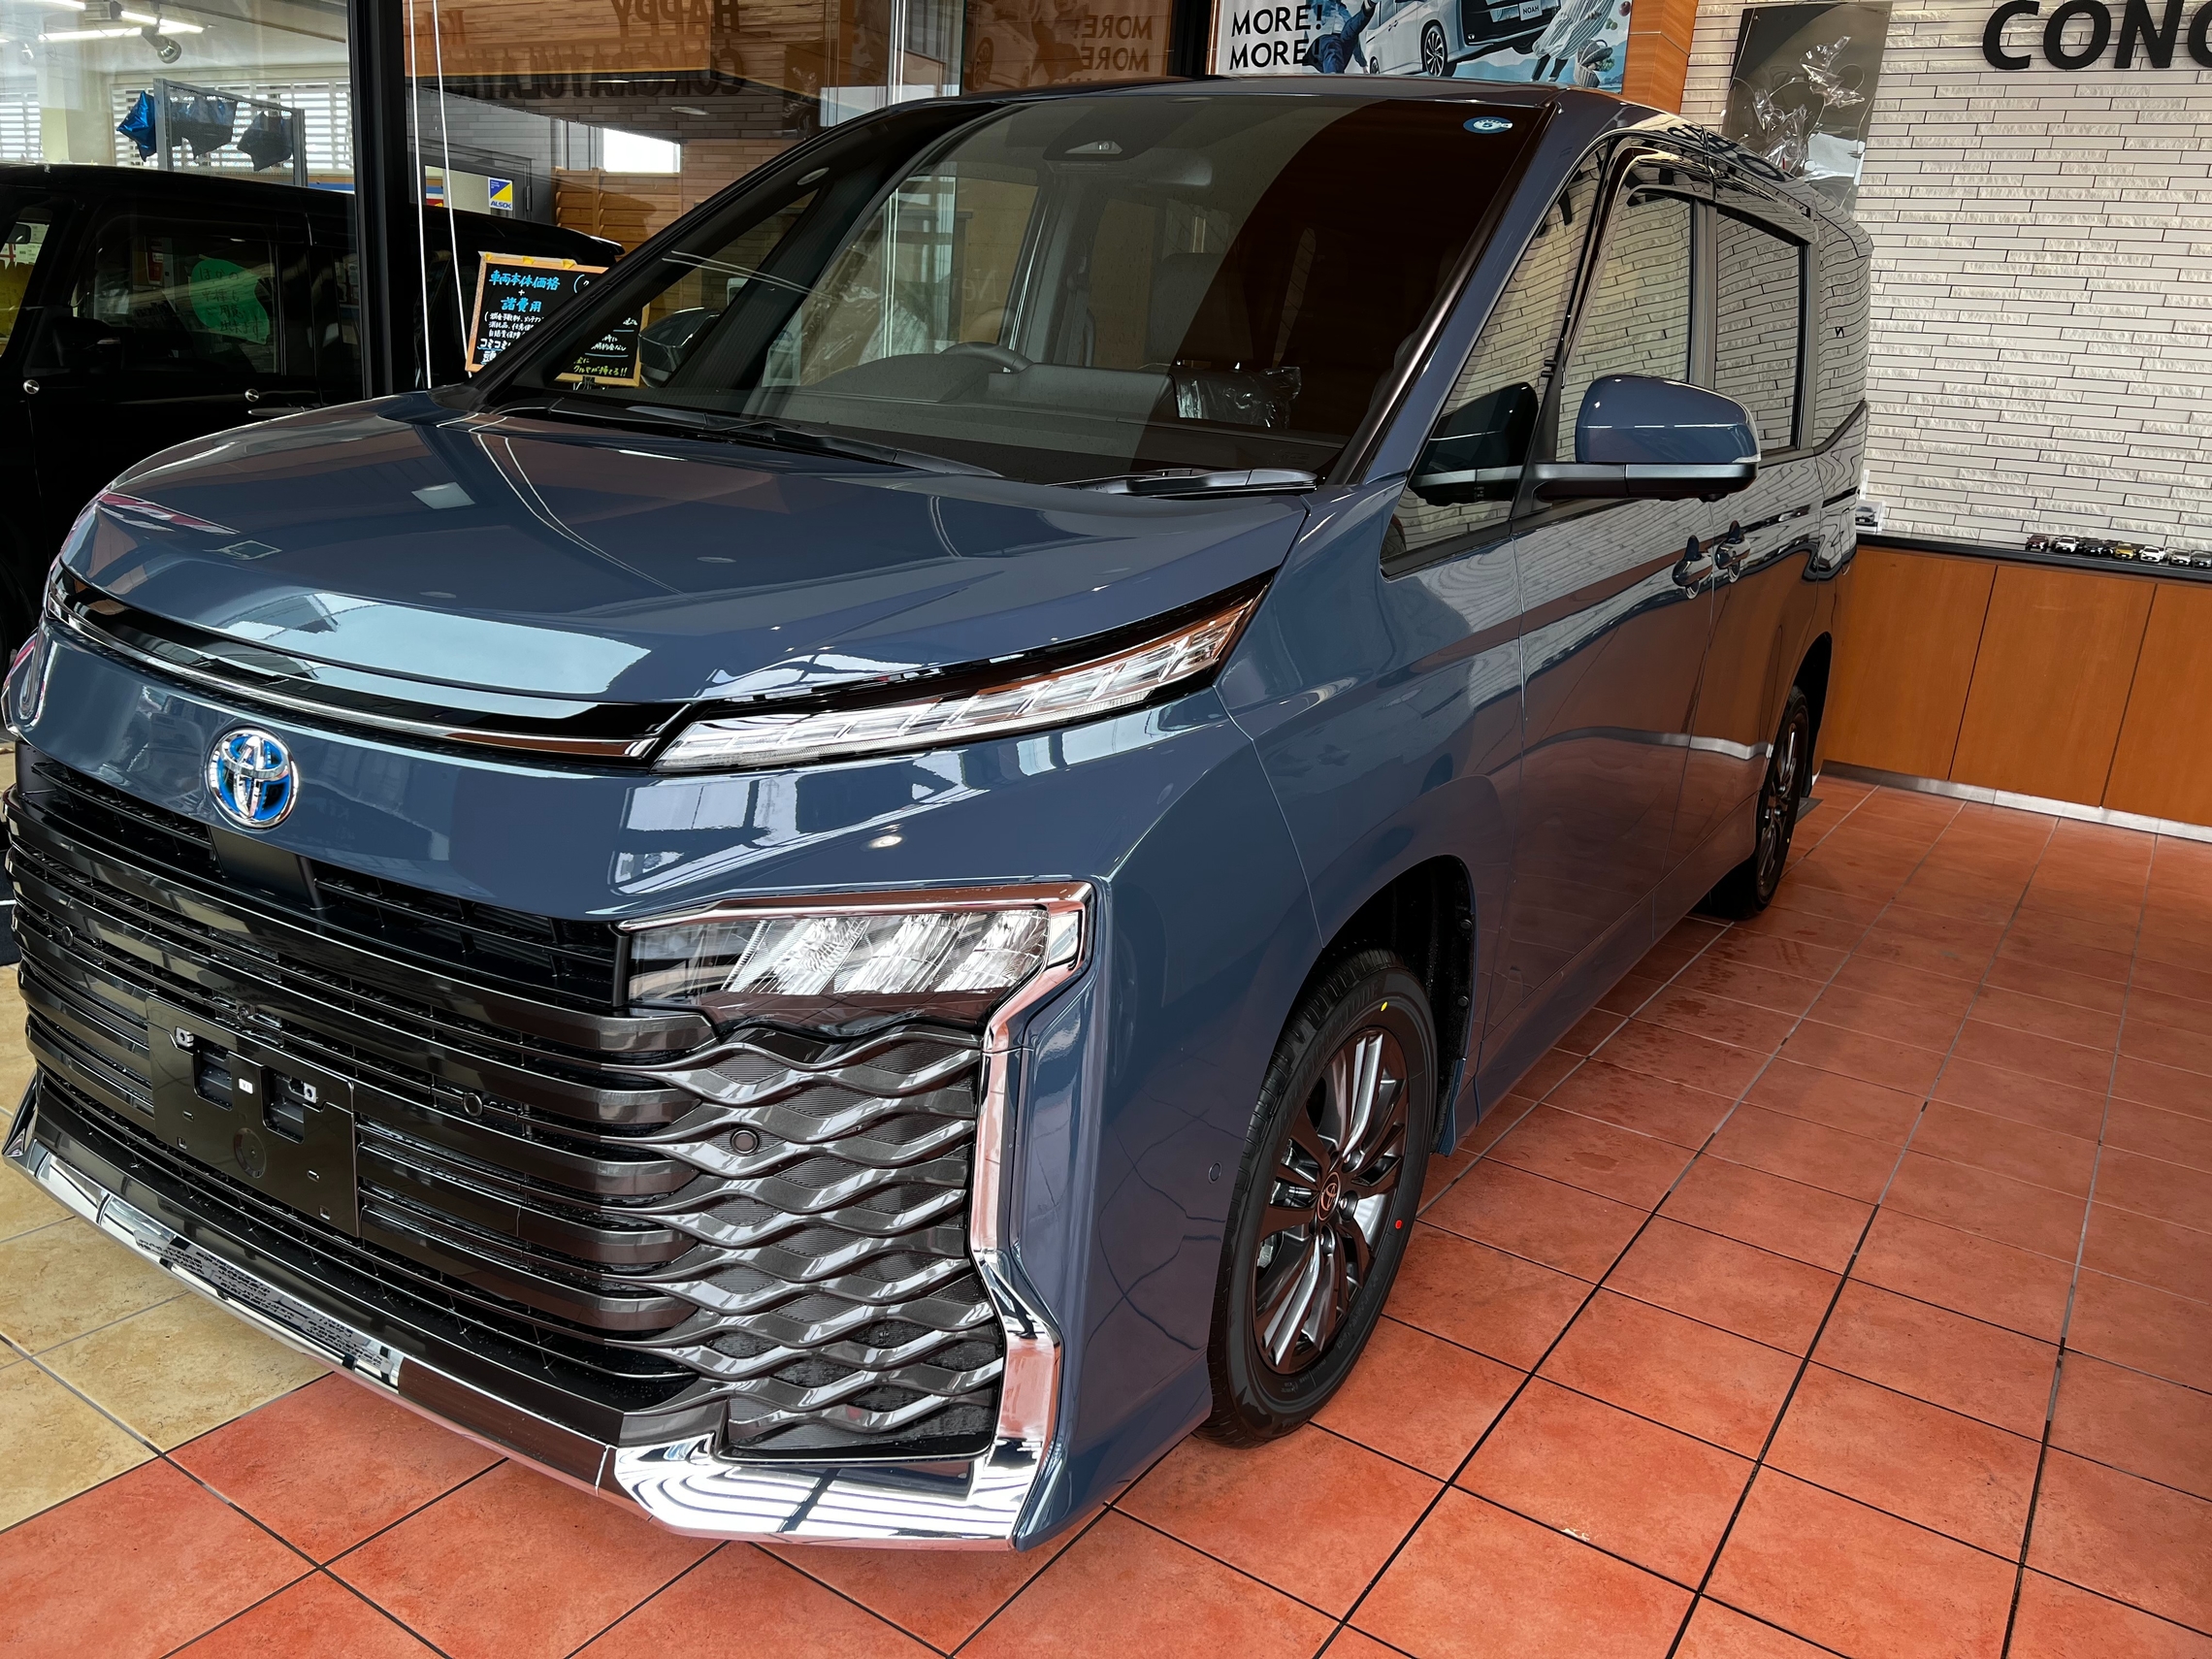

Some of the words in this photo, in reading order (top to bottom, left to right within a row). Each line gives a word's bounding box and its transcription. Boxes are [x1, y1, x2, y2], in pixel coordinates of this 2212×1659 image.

[1523, 5, 1540, 15] NOAH
[1231, 5, 1322, 37] MORE!
[1229, 39, 1319, 70] MORE!
[490, 201, 511, 210] ALSOK
[489, 270, 561, 291] 車両本体価格
[501, 297, 542, 312] 諸費用
[488, 330, 526, 340] 自賠責保険
[480, 338, 511, 350] コミコミ
